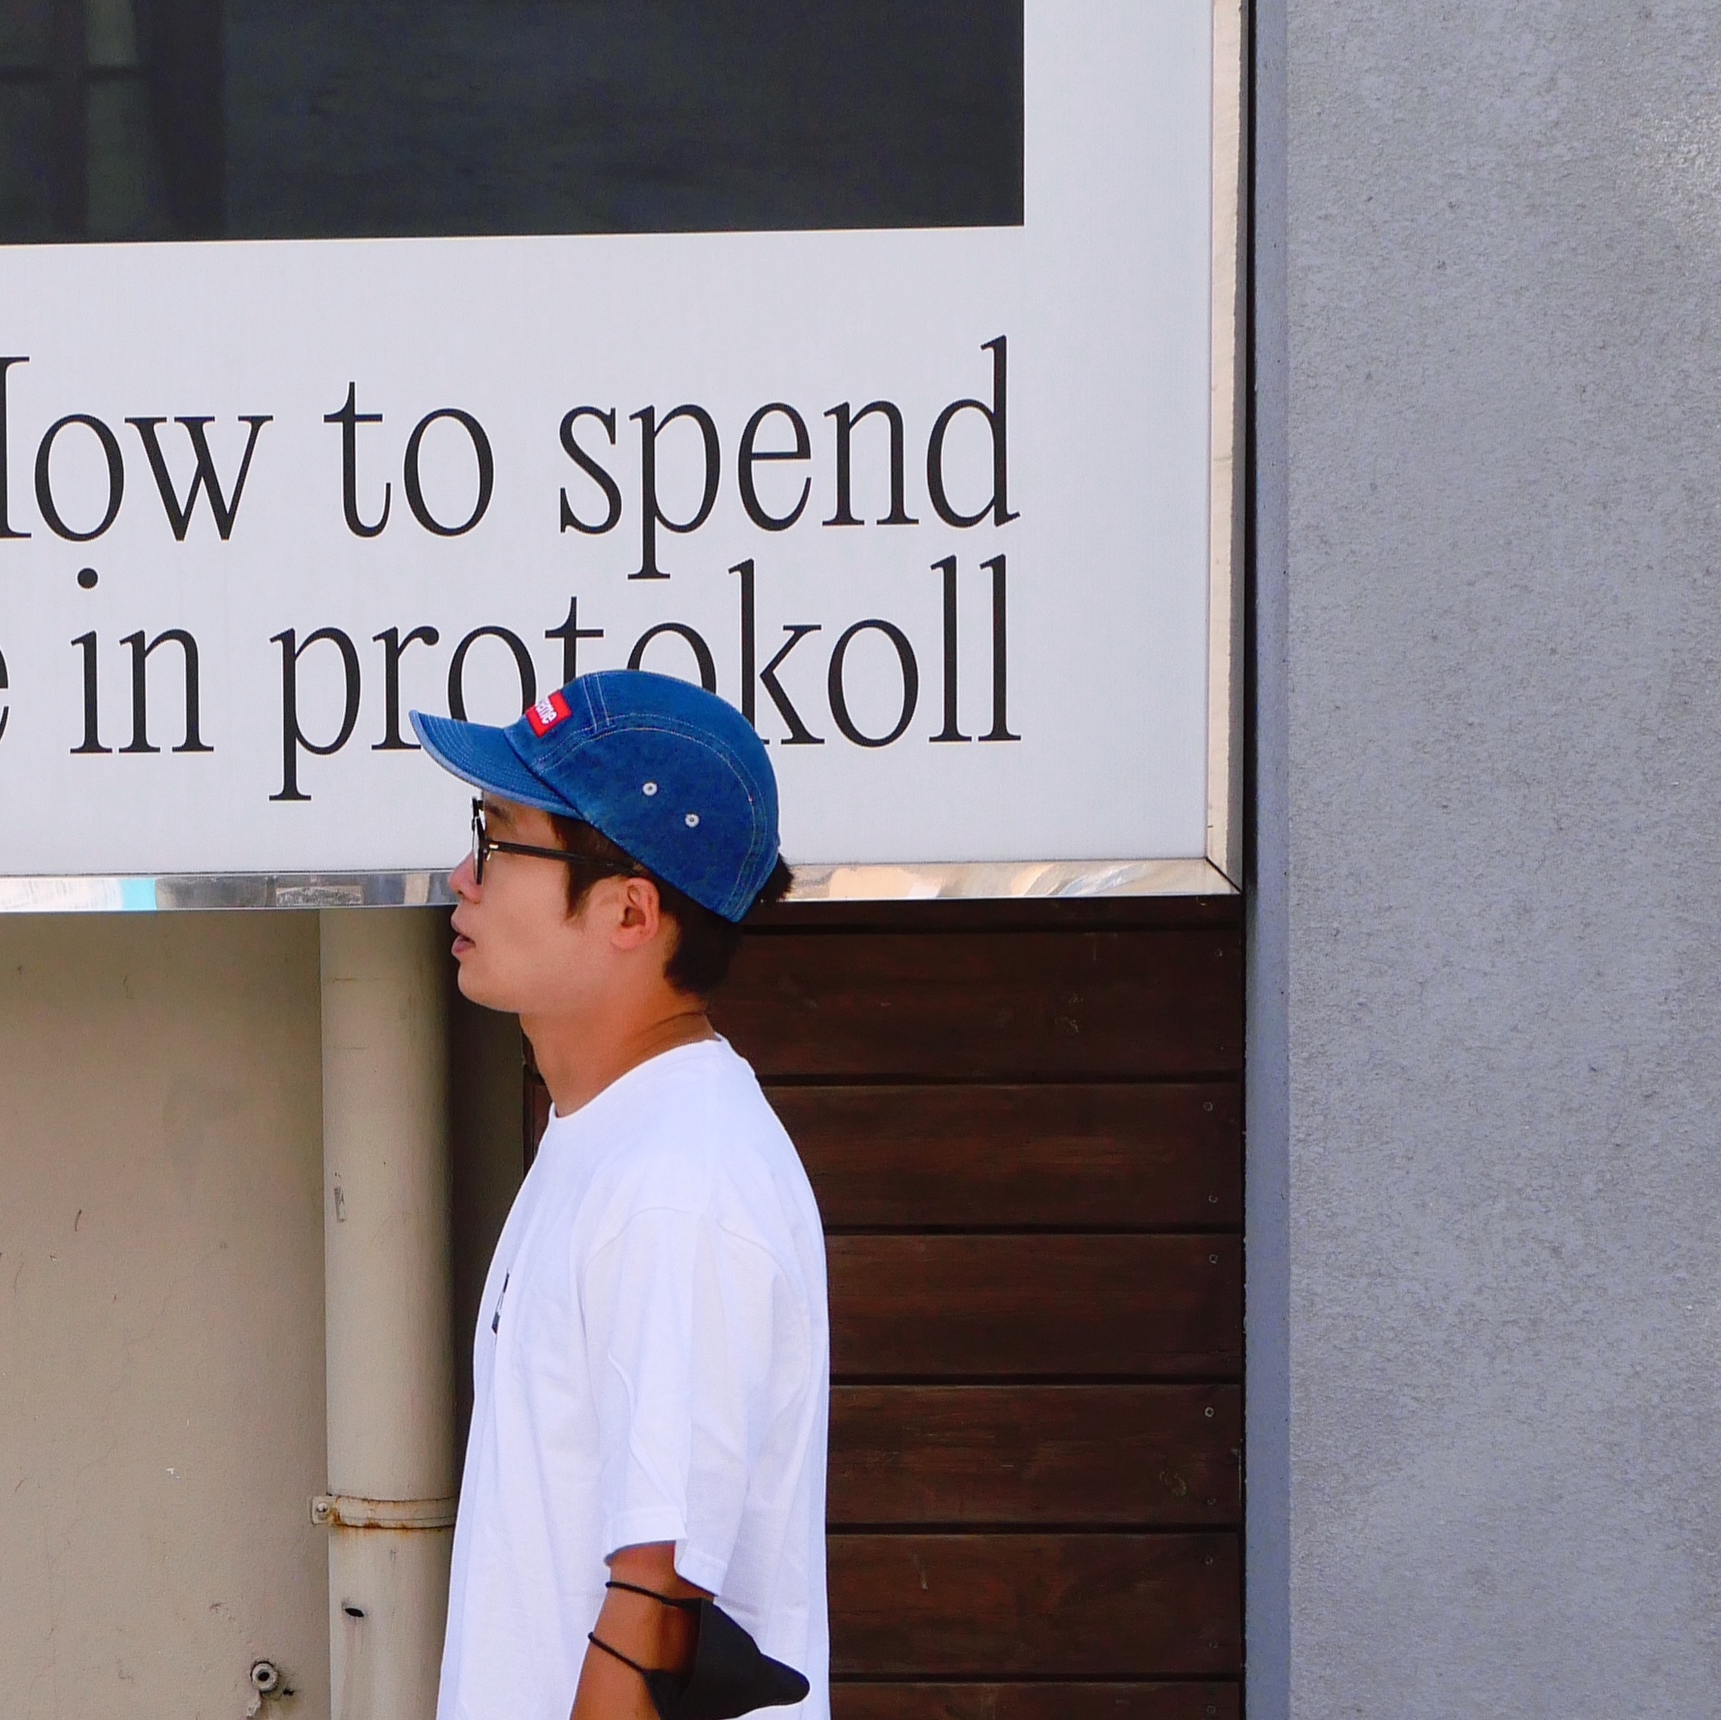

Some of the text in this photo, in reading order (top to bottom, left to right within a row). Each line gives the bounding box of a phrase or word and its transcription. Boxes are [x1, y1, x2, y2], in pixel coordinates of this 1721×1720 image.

[323, 381, 494, 538] to
[559, 334, 1021, 580] spend
[69, 567, 215, 754] in
